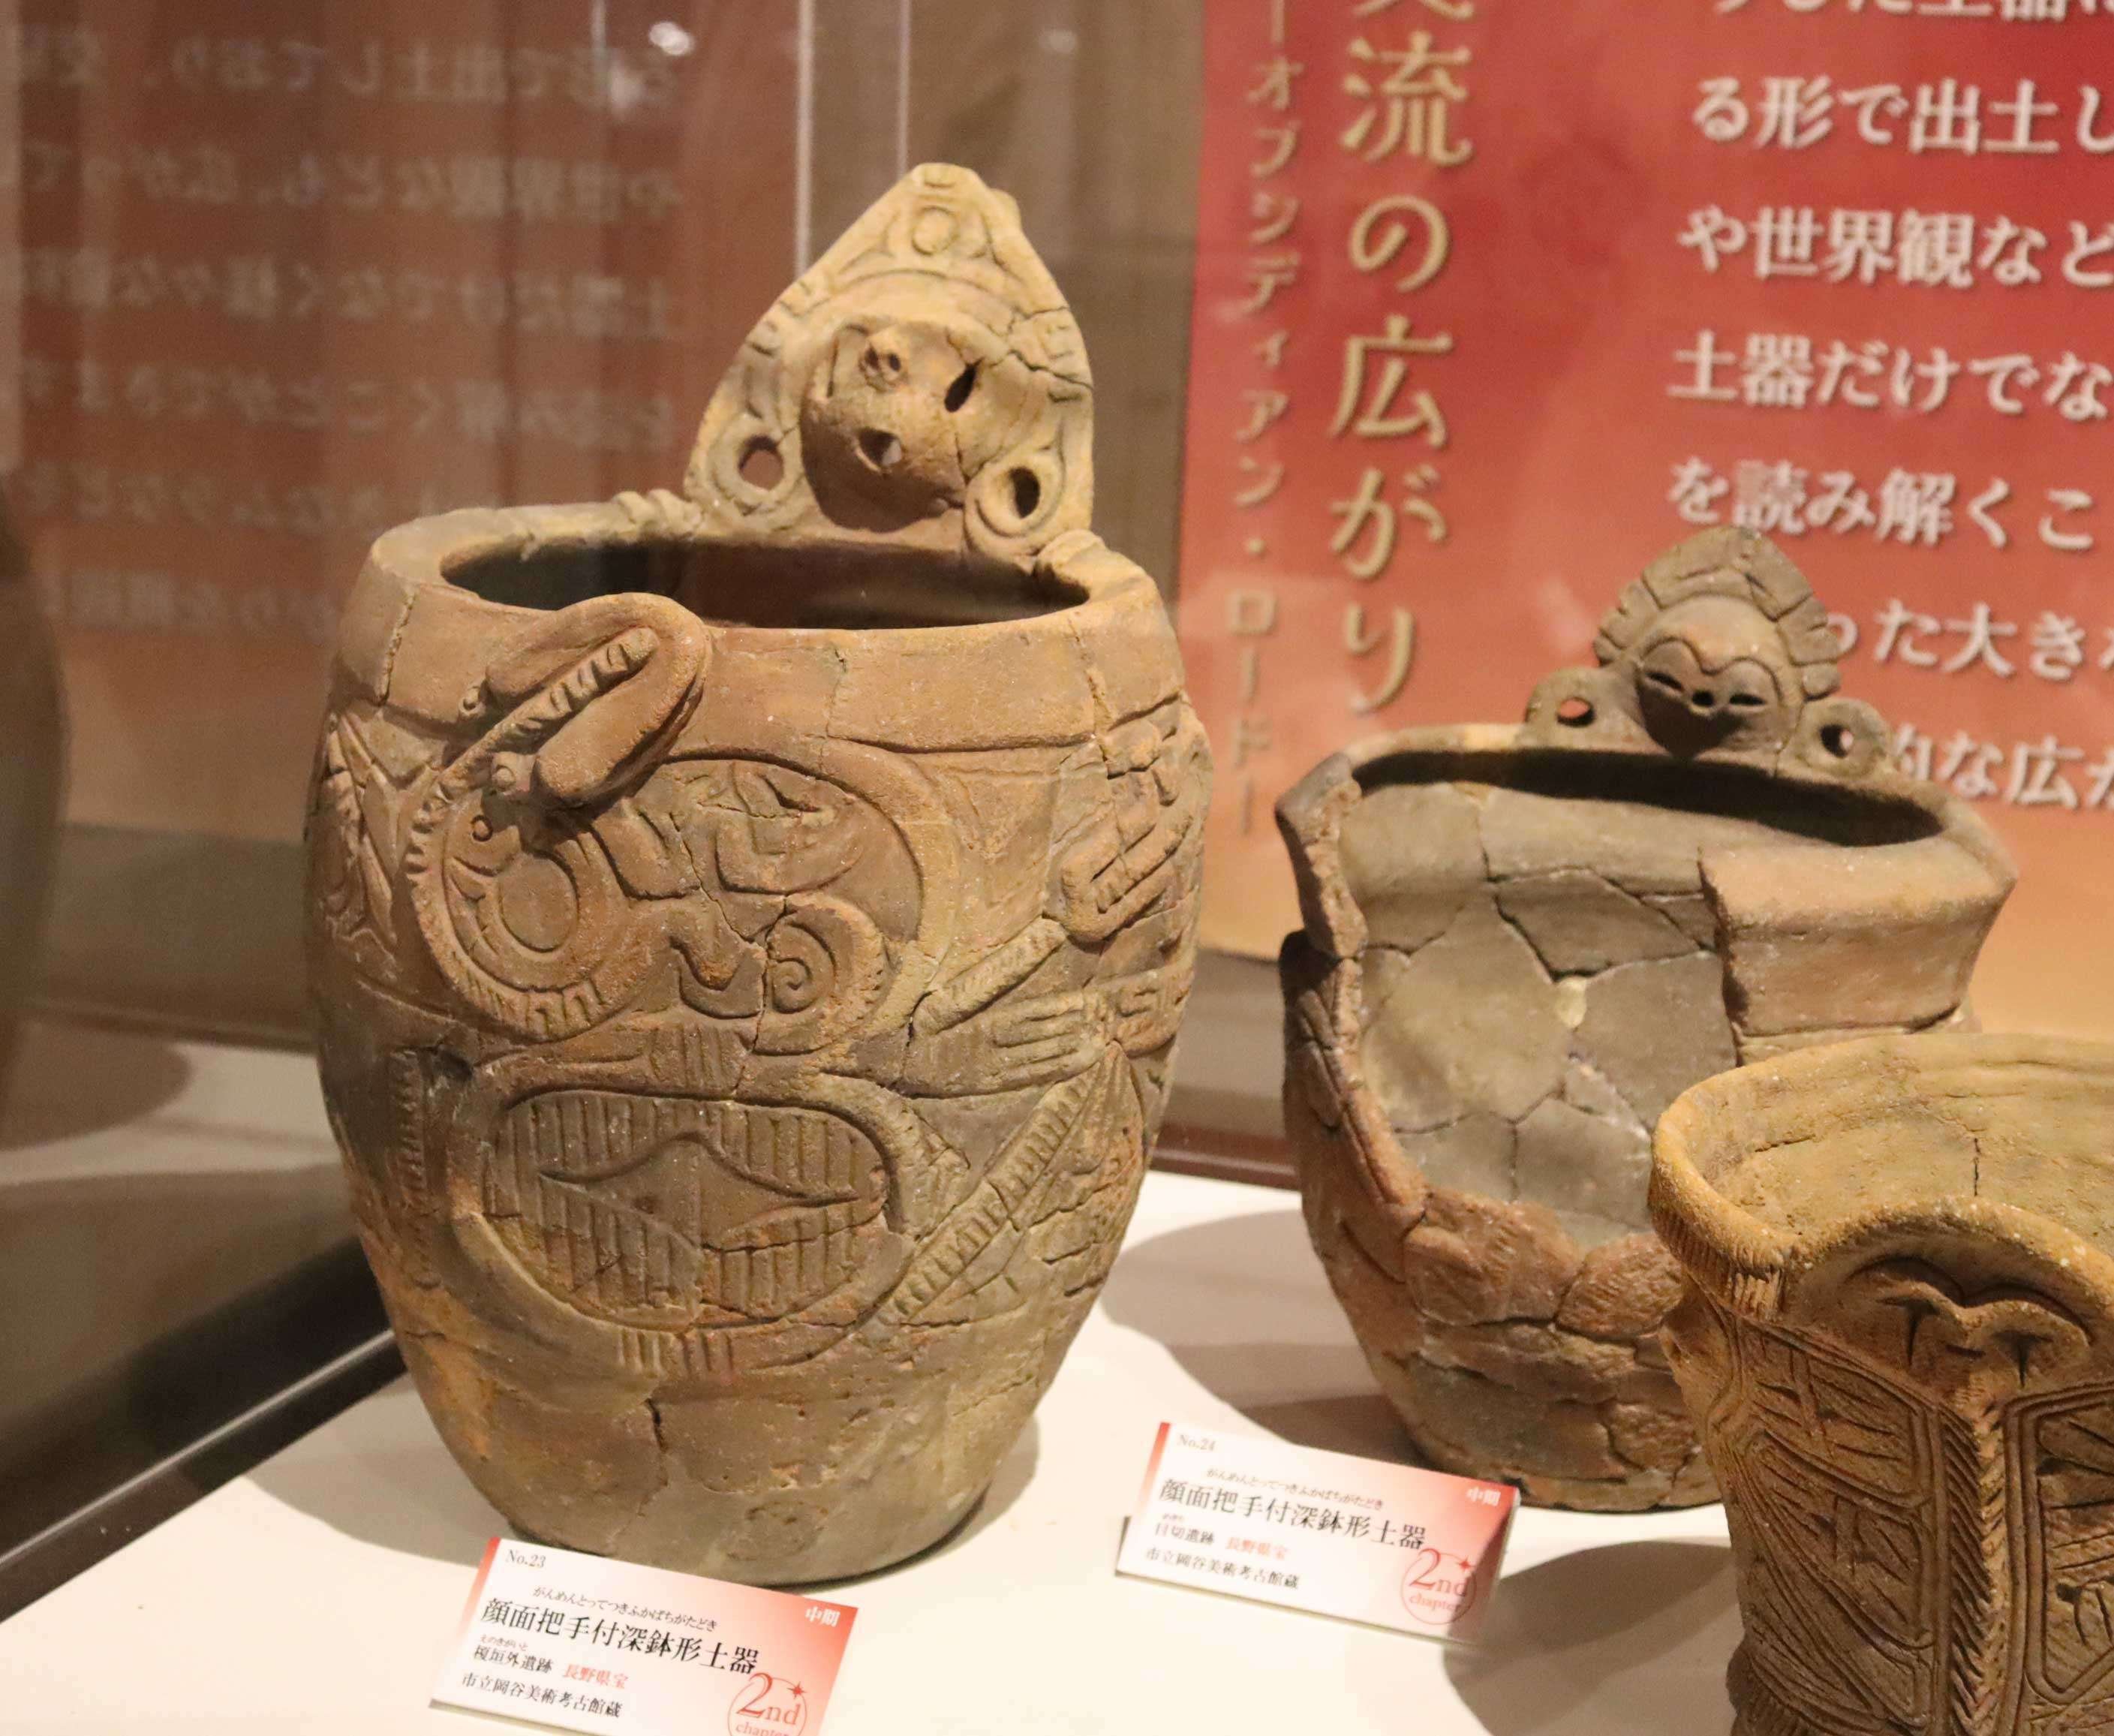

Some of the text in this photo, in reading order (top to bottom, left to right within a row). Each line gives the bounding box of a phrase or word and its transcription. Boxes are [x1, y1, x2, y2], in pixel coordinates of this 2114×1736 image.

[1693, 74, 2114, 155] る形で出土し
[1676, 203, 2114, 288] や世界観など
[1327, 0, 1475, 715] 流の広がり
[1665, 329, 2114, 423] 土器だけでな
[1667, 455, 2094, 551] を読み解くこ
[1177, 1433, 1216, 1452] No.24
[1159, 1479, 1426, 1550] 顔面把手付深鉢形土器
[504, 1548, 546, 1569] No.23
[480, 1596, 759, 1674] 顔面把手付深鉢形土器
[462, 1672, 624, 1719] 市立岡谷美術考古館蔵
[563, 1663, 630, 1689] 長野県宝
[735, 1671, 801, 1726] 2nd
